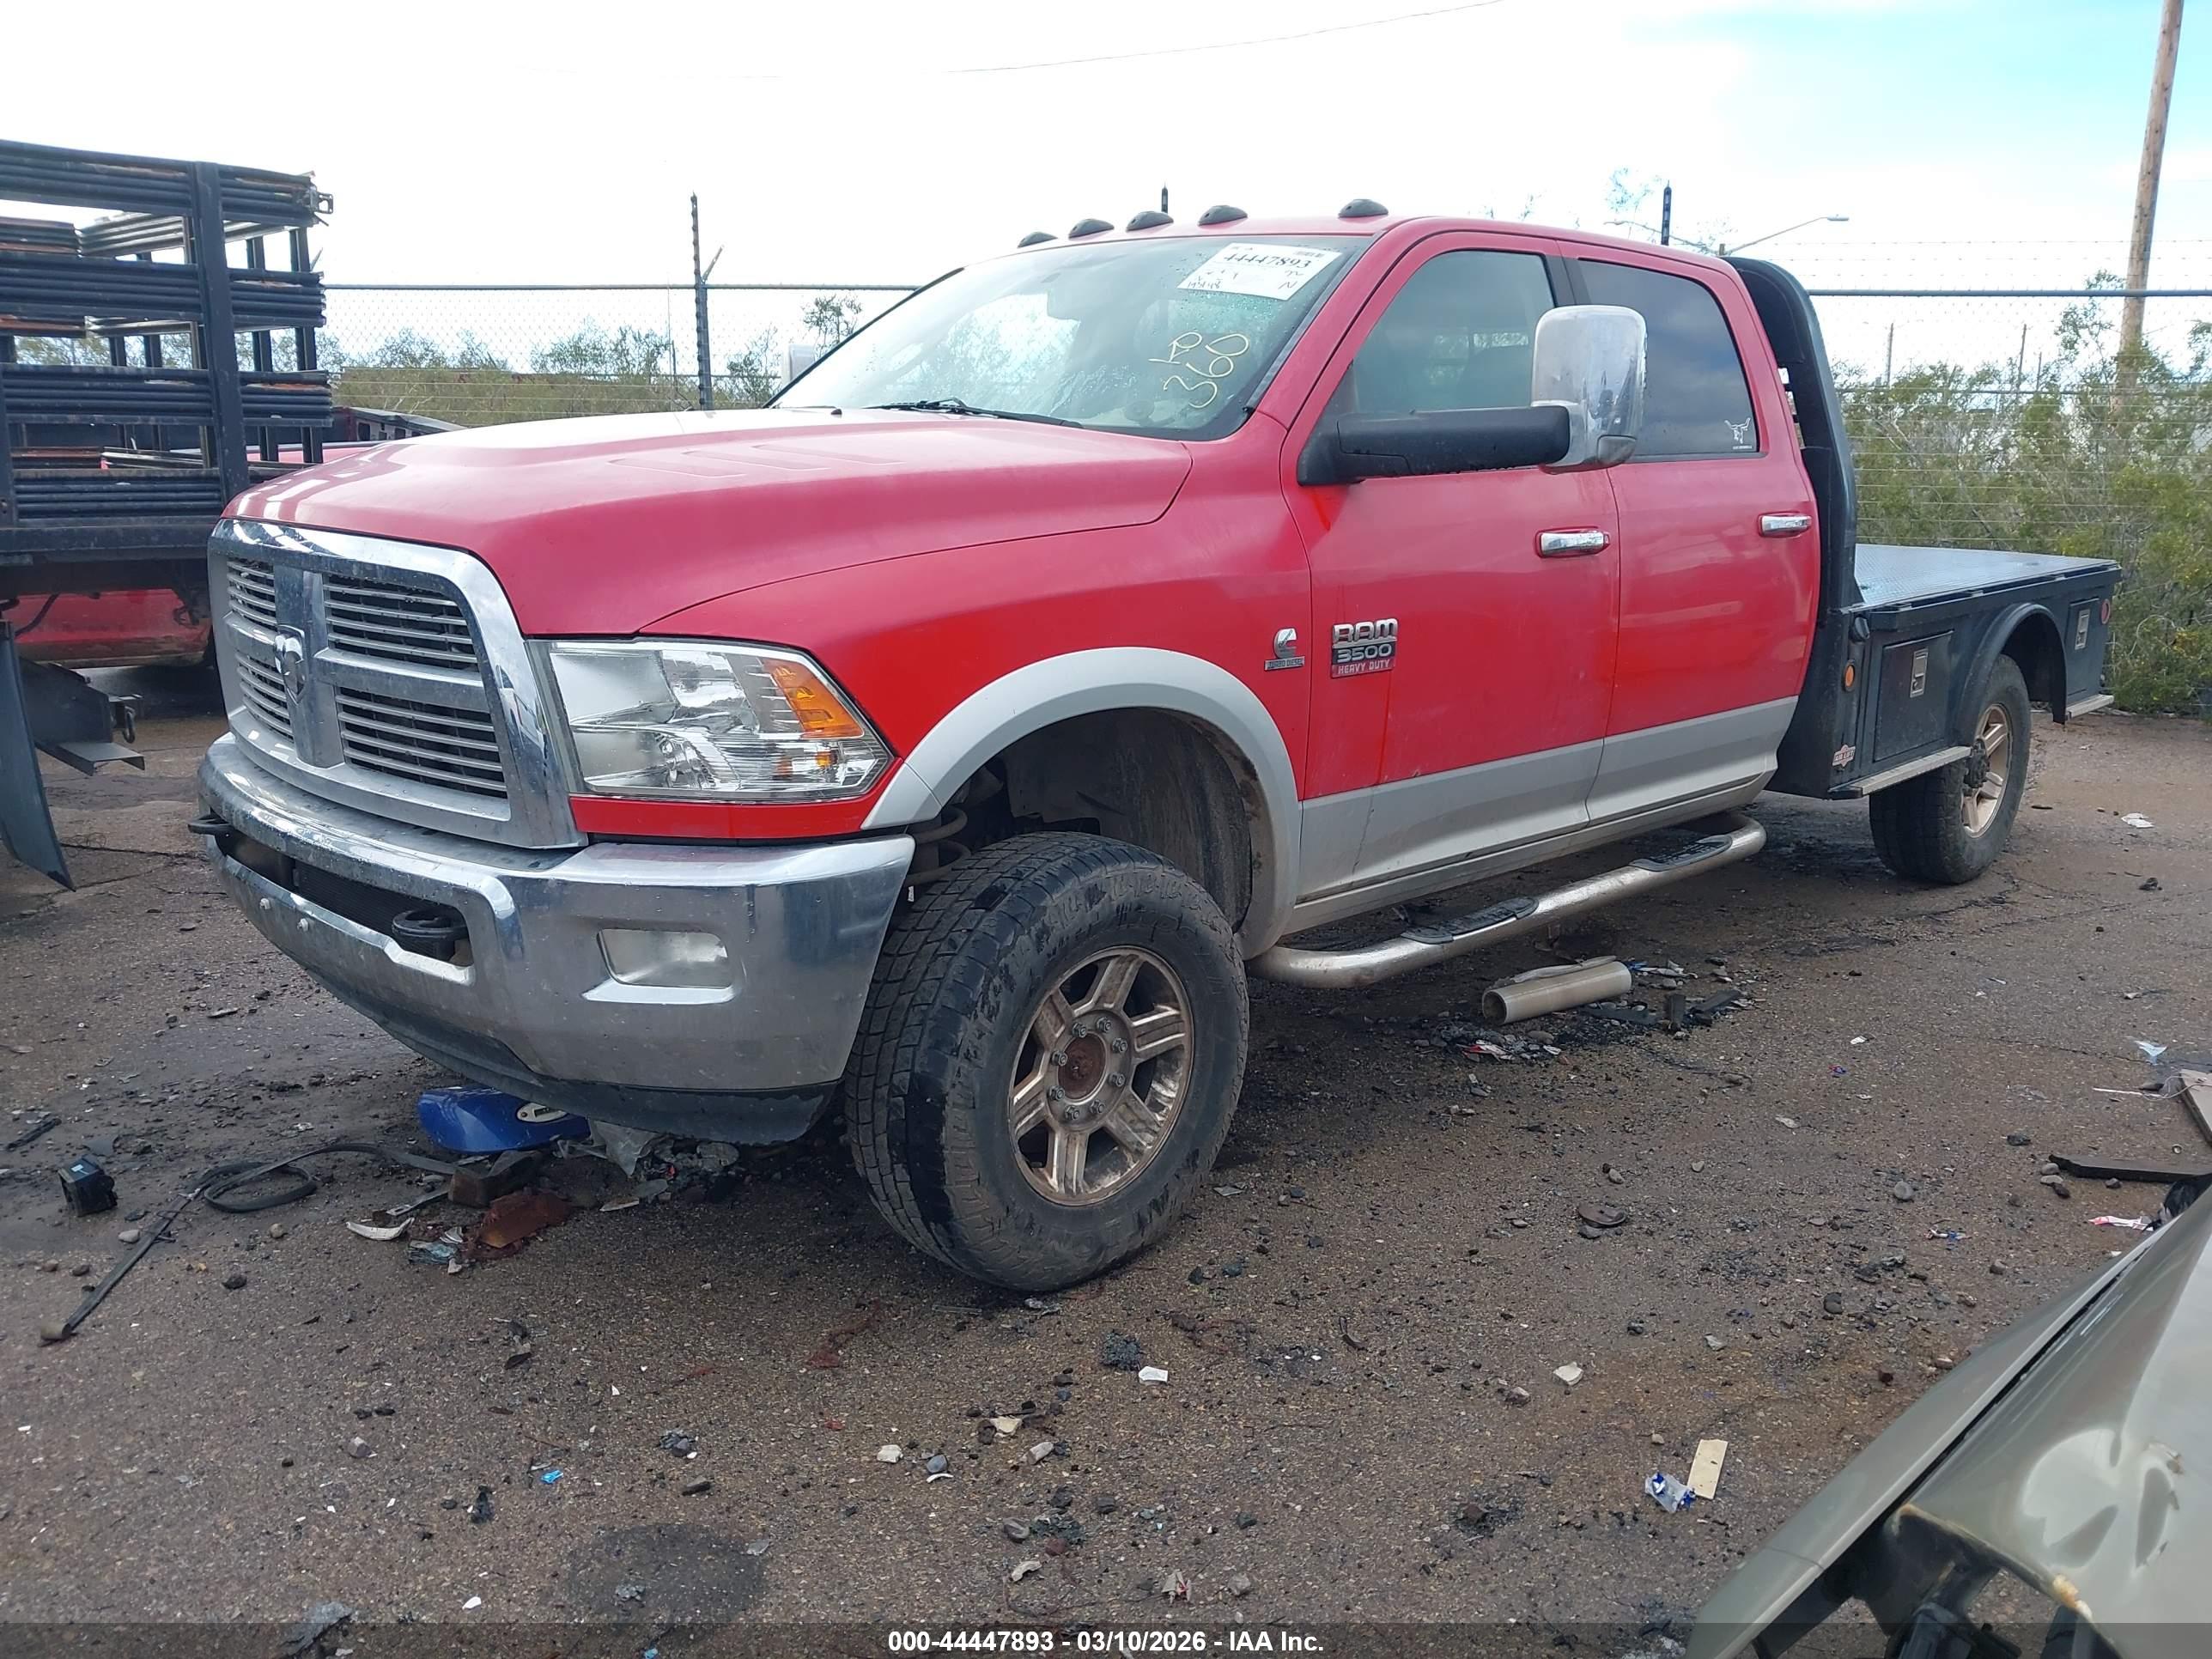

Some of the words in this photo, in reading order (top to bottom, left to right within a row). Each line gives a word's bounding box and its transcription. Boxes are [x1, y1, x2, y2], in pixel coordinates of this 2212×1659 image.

[1224, 252, 1312, 269] 44447893
[1162, 332, 1249, 409] 360
[1332, 617, 1398, 644] RAM
[1337, 643, 1393, 664] 3500
[1338, 662, 1366, 675] HEAVY
[1369, 659, 1390, 671] DUTY
